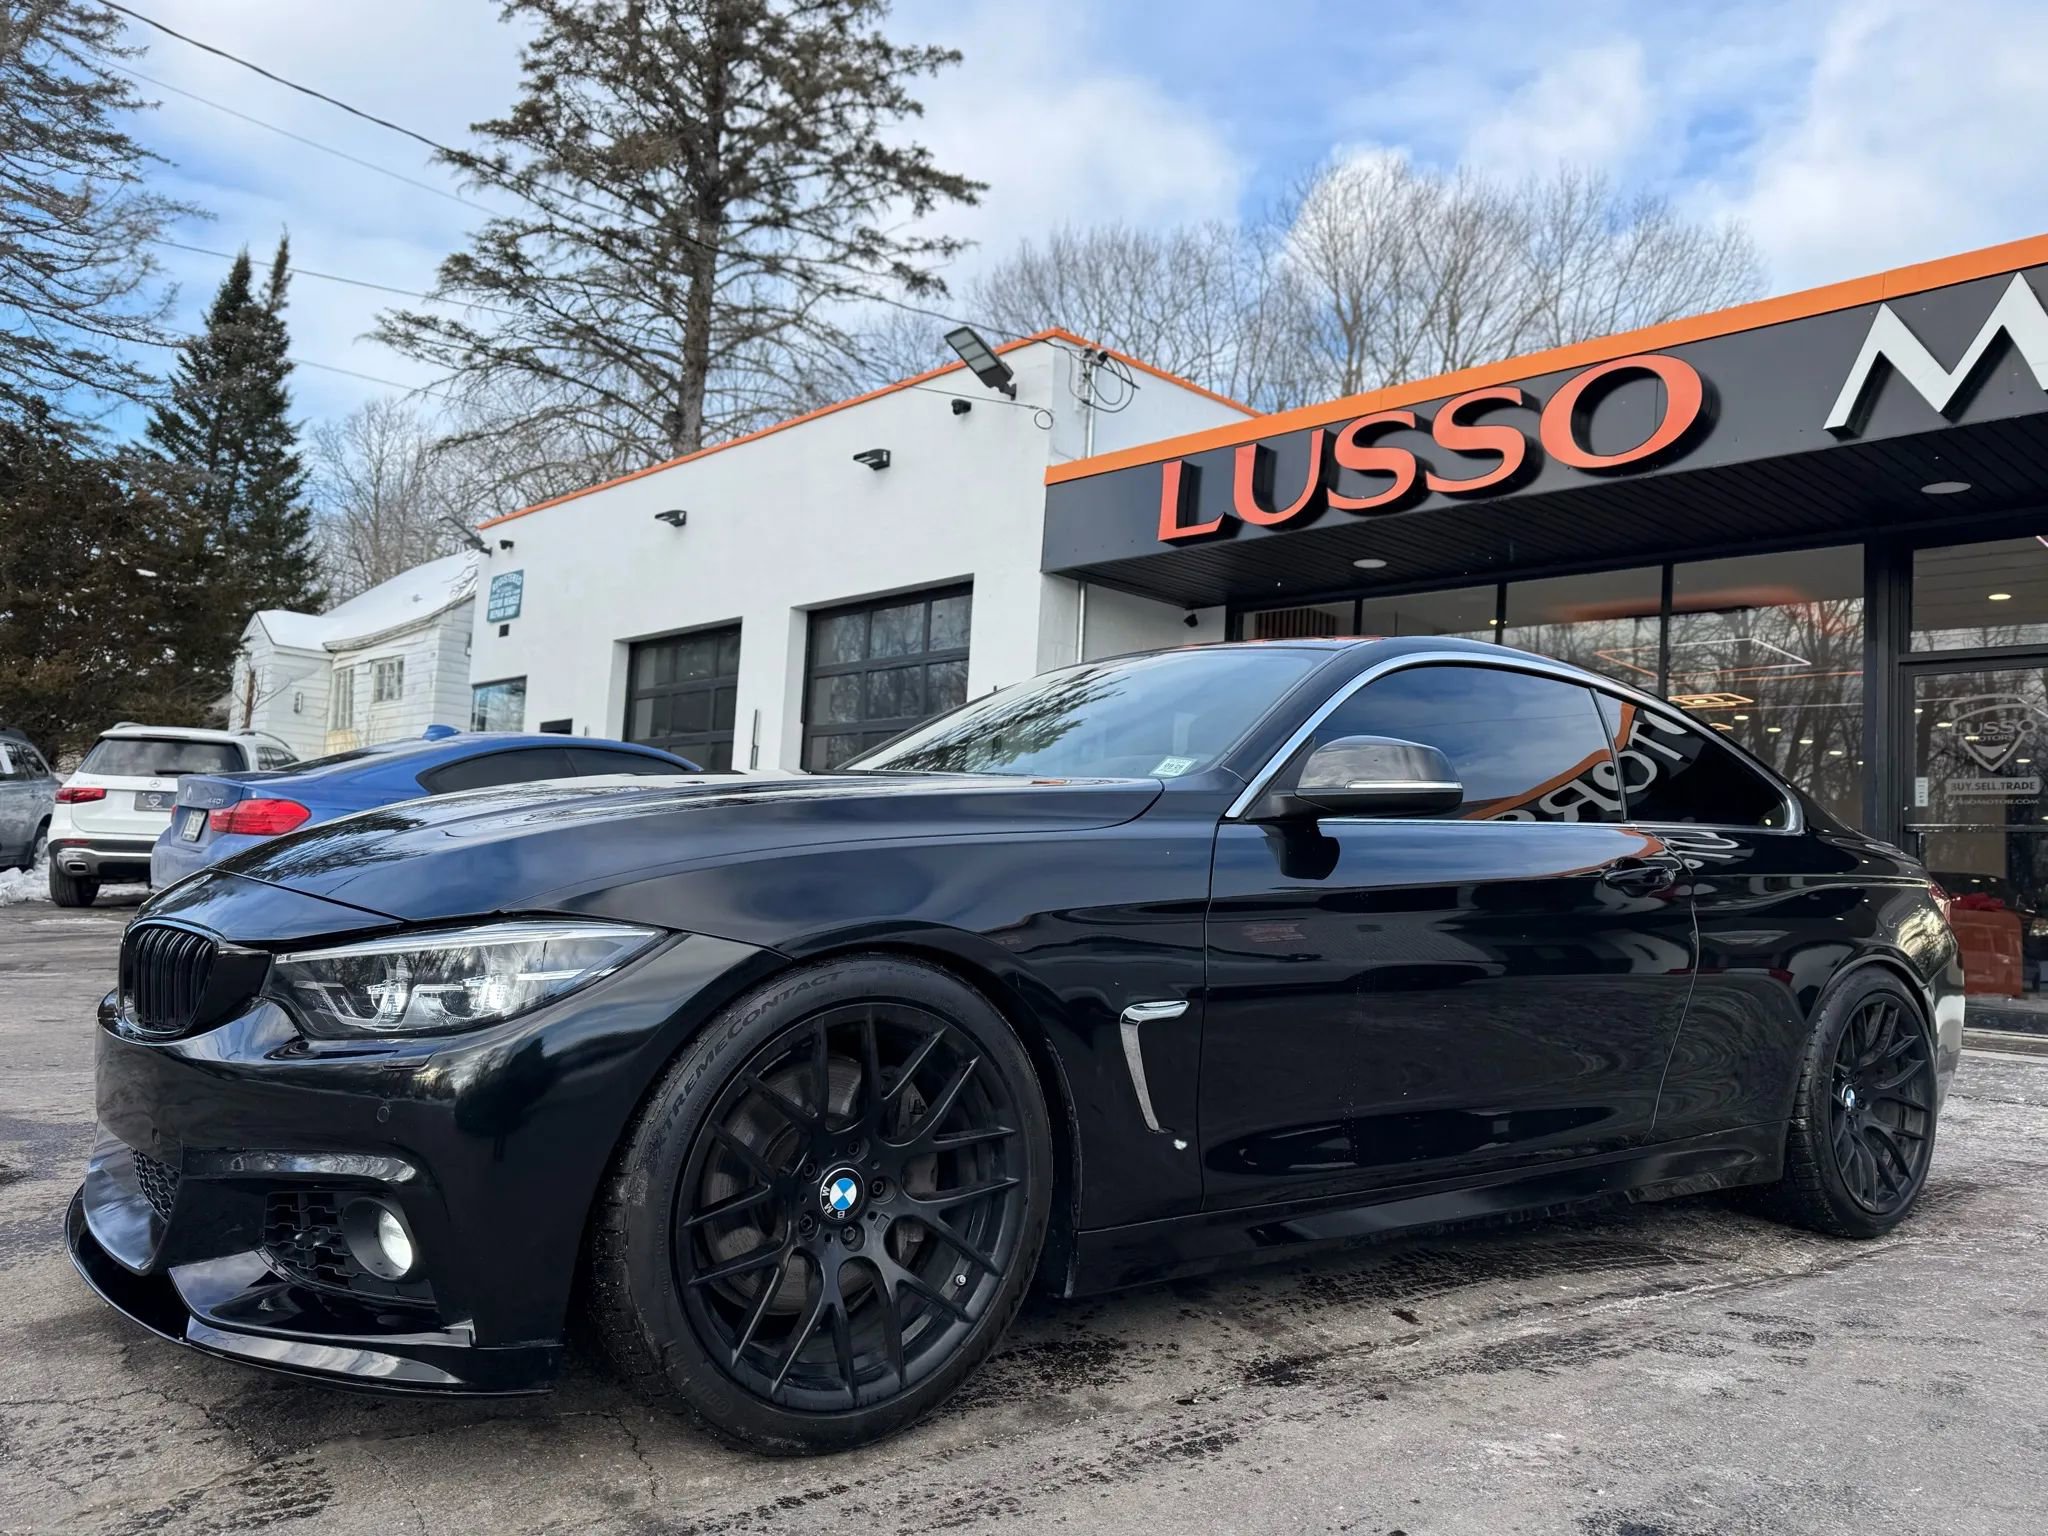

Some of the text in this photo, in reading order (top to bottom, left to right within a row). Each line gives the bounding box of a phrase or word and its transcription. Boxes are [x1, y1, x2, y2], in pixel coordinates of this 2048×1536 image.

[1158, 272, 2048, 543] LUSSO M
[1952, 720, 2037, 736] LUSSO
[821, 1185, 846, 1219] BMW
